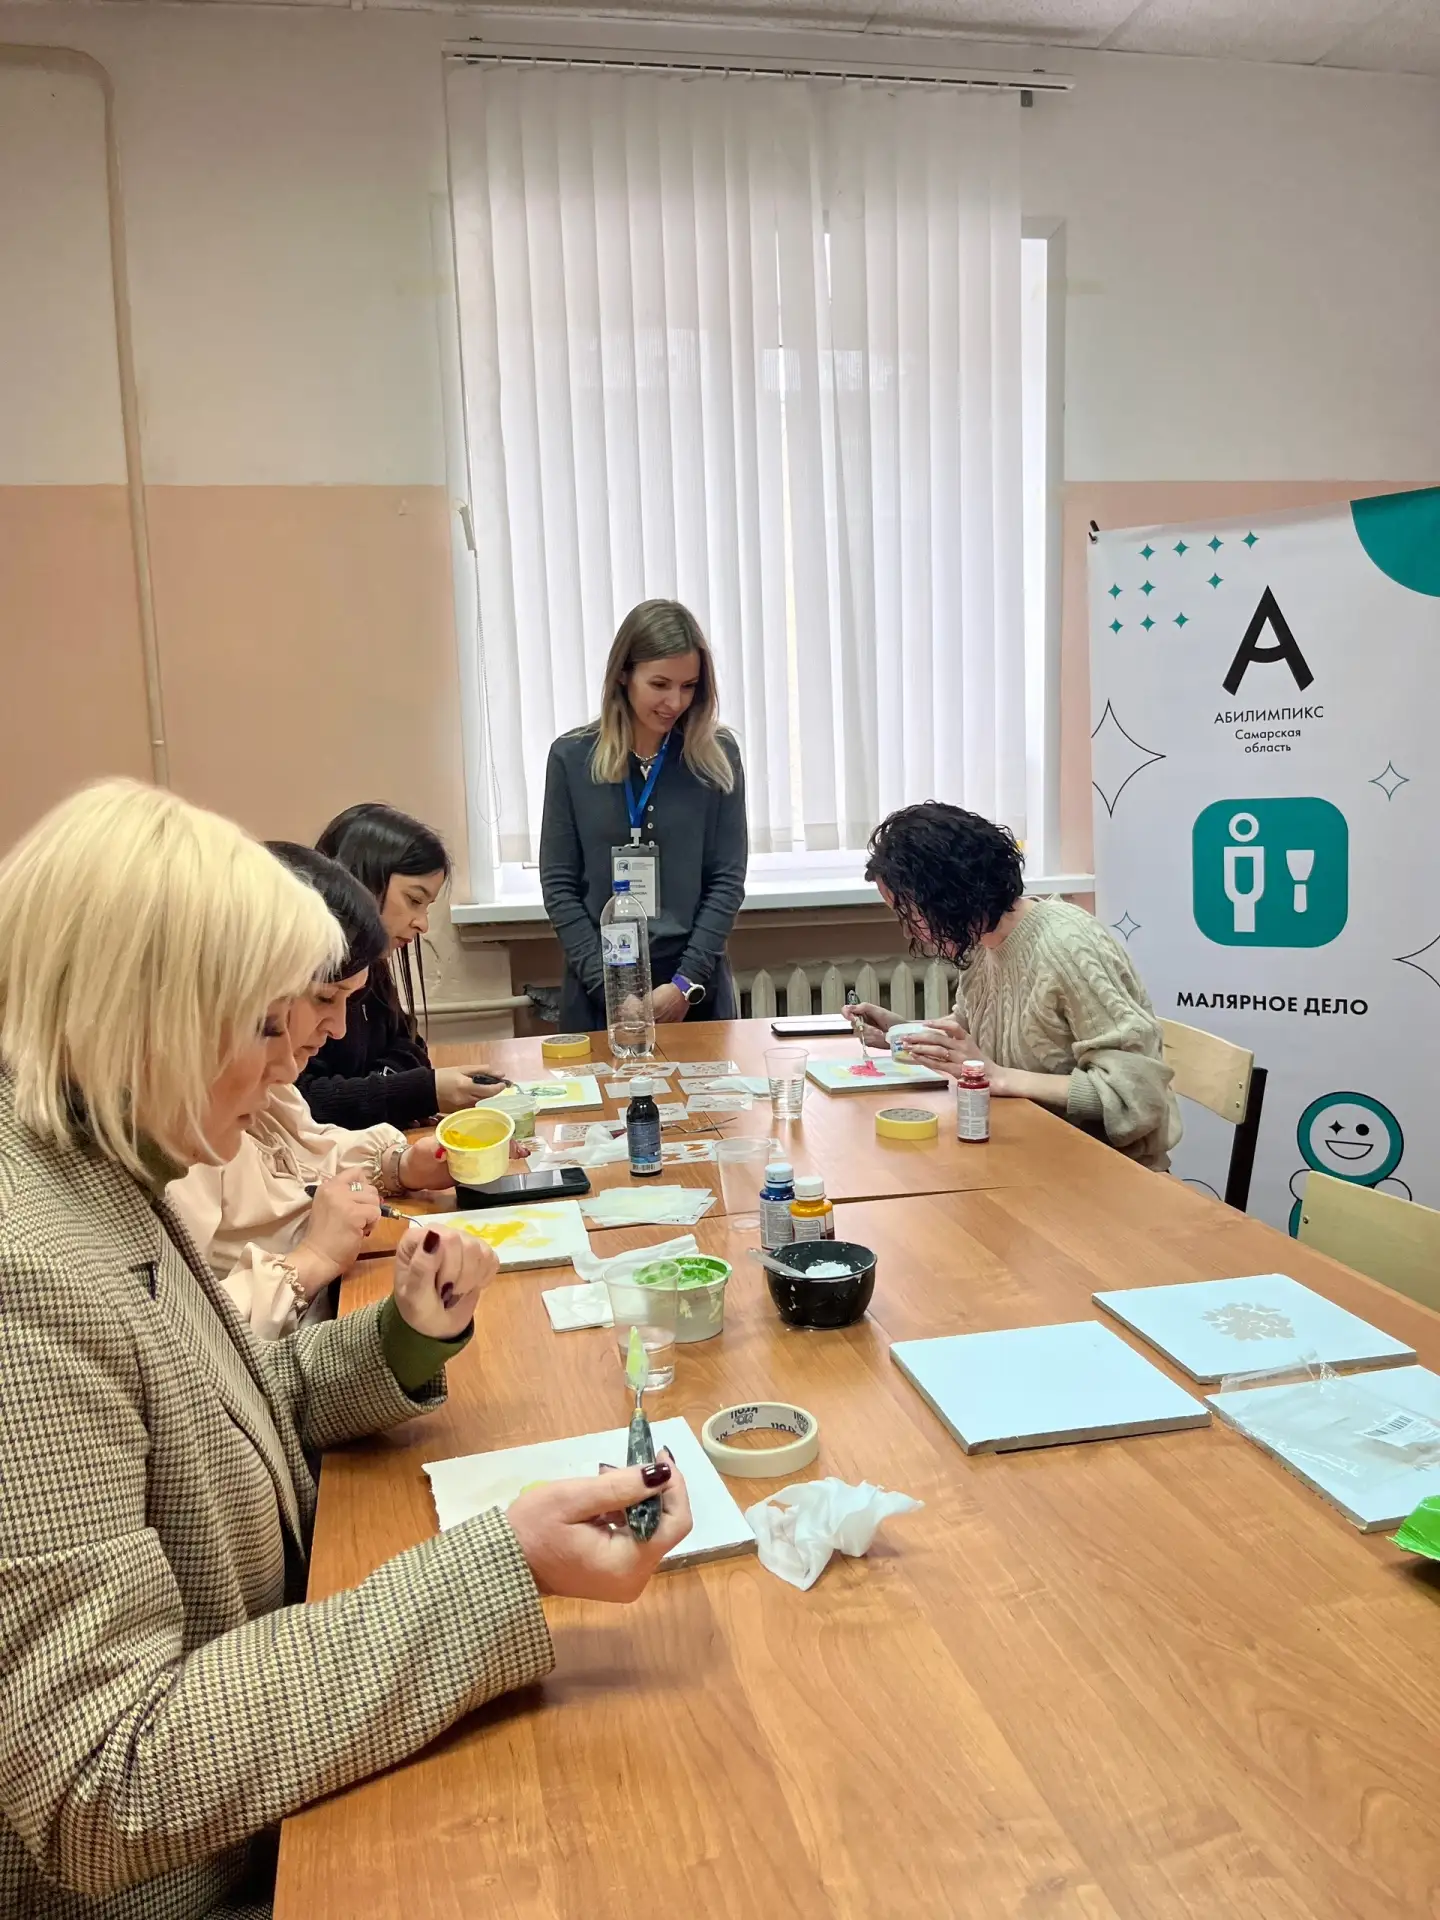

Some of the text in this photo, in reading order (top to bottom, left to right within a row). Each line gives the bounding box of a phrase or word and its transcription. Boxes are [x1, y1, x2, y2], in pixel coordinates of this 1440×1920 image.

[1214, 705, 1325, 725] АБИЛИМПИКС
[1235, 728, 1302, 742] Самарская
[1244, 742, 1292, 754] область
[1176, 991, 1369, 1016] МАЛЯРНОЕ ДЕЛО
